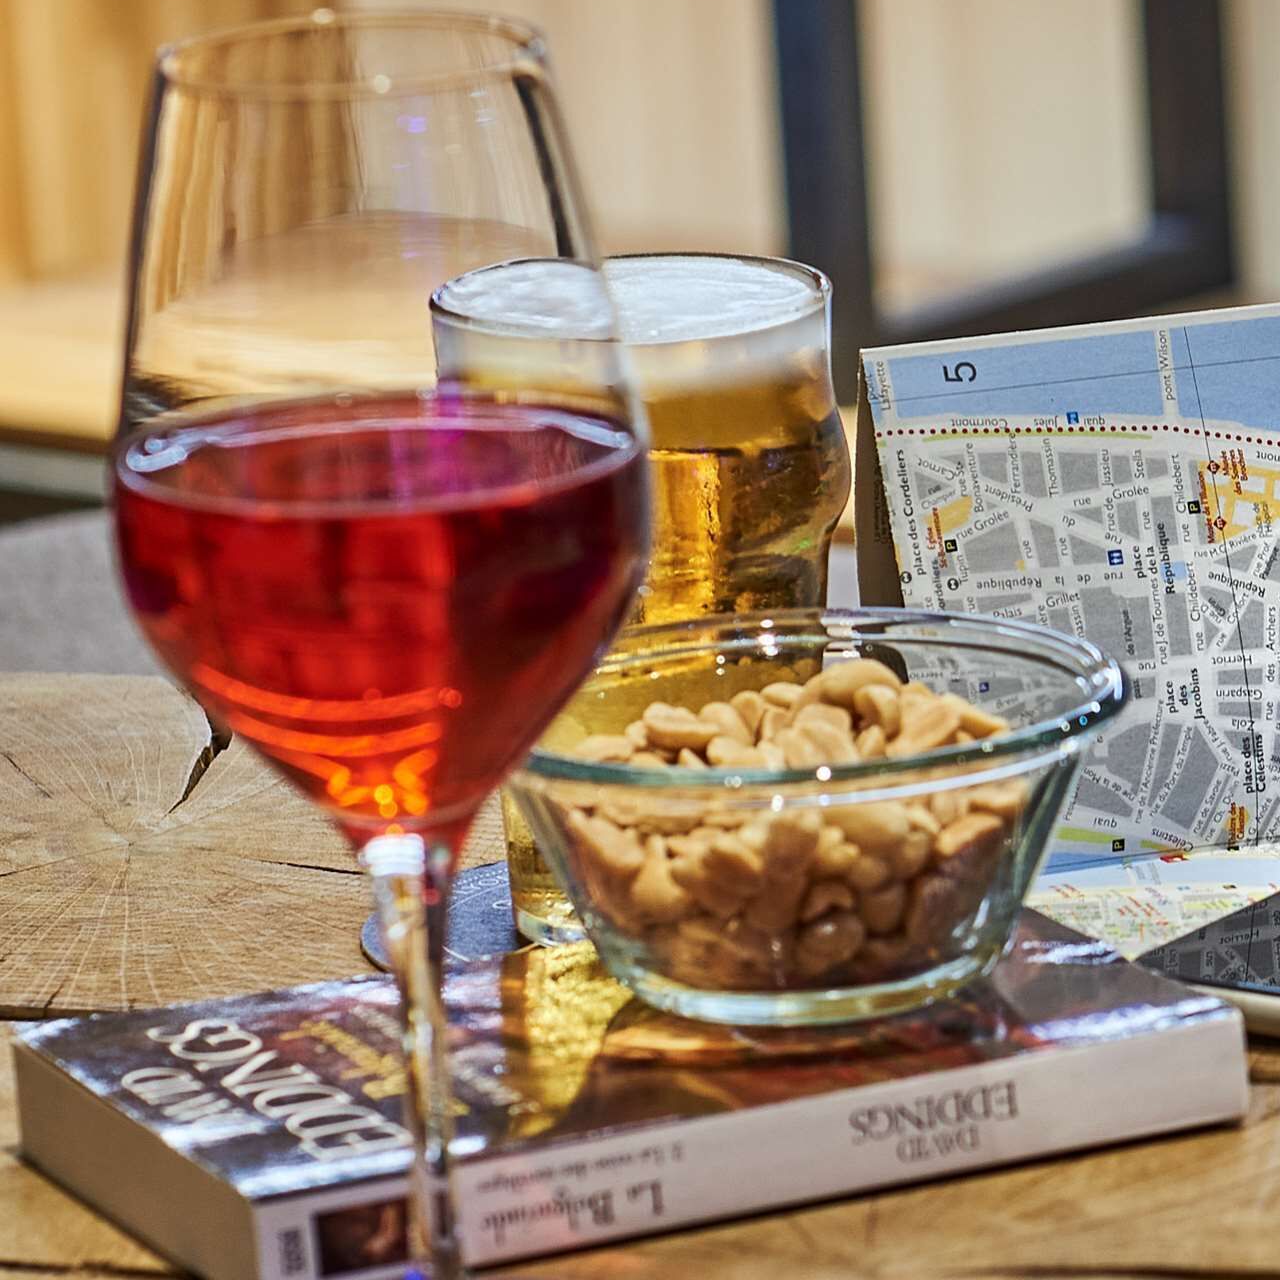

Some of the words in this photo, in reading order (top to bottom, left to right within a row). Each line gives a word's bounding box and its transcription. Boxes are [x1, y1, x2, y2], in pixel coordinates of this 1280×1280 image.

[1159, 329, 1170, 371] Wilson
[943, 362, 976, 383] 5
[1166, 375, 1175, 401] pont
[951, 418, 1008, 430] Courmont
[1034, 418, 1060, 429] Jules
[1083, 415, 1105, 426] quai
[964, 442, 984, 512] Bonaventure
[1042, 438, 1058, 497] Thomassin
[897, 448, 914, 517] Cordeliers
[1171, 453, 1187, 514] Childebert
[1073, 497, 1092, 507] rue
[1113, 485, 1149, 500] Grolée
[1104, 497, 1113, 511] de
[956, 527, 973, 541] rue
[974, 510, 1009, 531] Grolée
[984, 485, 1033, 512] Président
[1062, 514, 1075, 527] du
[1105, 531, 1123, 545] rue
[1109, 512, 1118, 532] rue
[911, 524, 921, 541] des
[1024, 541, 1033, 559] rue
[1060, 537, 1068, 557] rue
[1147, 546, 1155, 559] la
[916, 554, 926, 576] place
[1133, 545, 1147, 580] place
[1150, 559, 1158, 575] de
[1157, 523, 1175, 595] République
[976, 576, 1042, 590] République
[1055, 575, 1064, 586] la
[1077, 574, 1091, 585] de
[1104, 571, 1123, 581] rue
[1209, 572, 1265, 598] République
[1046, 592, 1080, 609] Grillet
[1152, 577, 1164, 623] Tournes
[1187, 562, 1201, 623] Childebert
[1196, 632, 1204, 652] rue
[1266, 606, 1276, 652] Archers
[1139, 661, 1157, 671] rue
[1211, 652, 1252, 666] Herriot
[1266, 663, 1276, 683] des
[1168, 681, 1178, 714] place
[1179, 685, 1188, 706] des
[1188, 668, 1206, 720] Jacobins
[1215, 689, 1263, 700] Gasparin
[1231, 718, 1255, 731] Zola
[1240, 736, 1250, 762] des
[1244, 763, 1256, 795] place
[1092, 816, 1117, 829] quai
[146, 1019, 416, 1161] EDDINGS
[848, 1079, 1019, 1144] EDDINGS
[896, 1125, 980, 1163] DAVID
